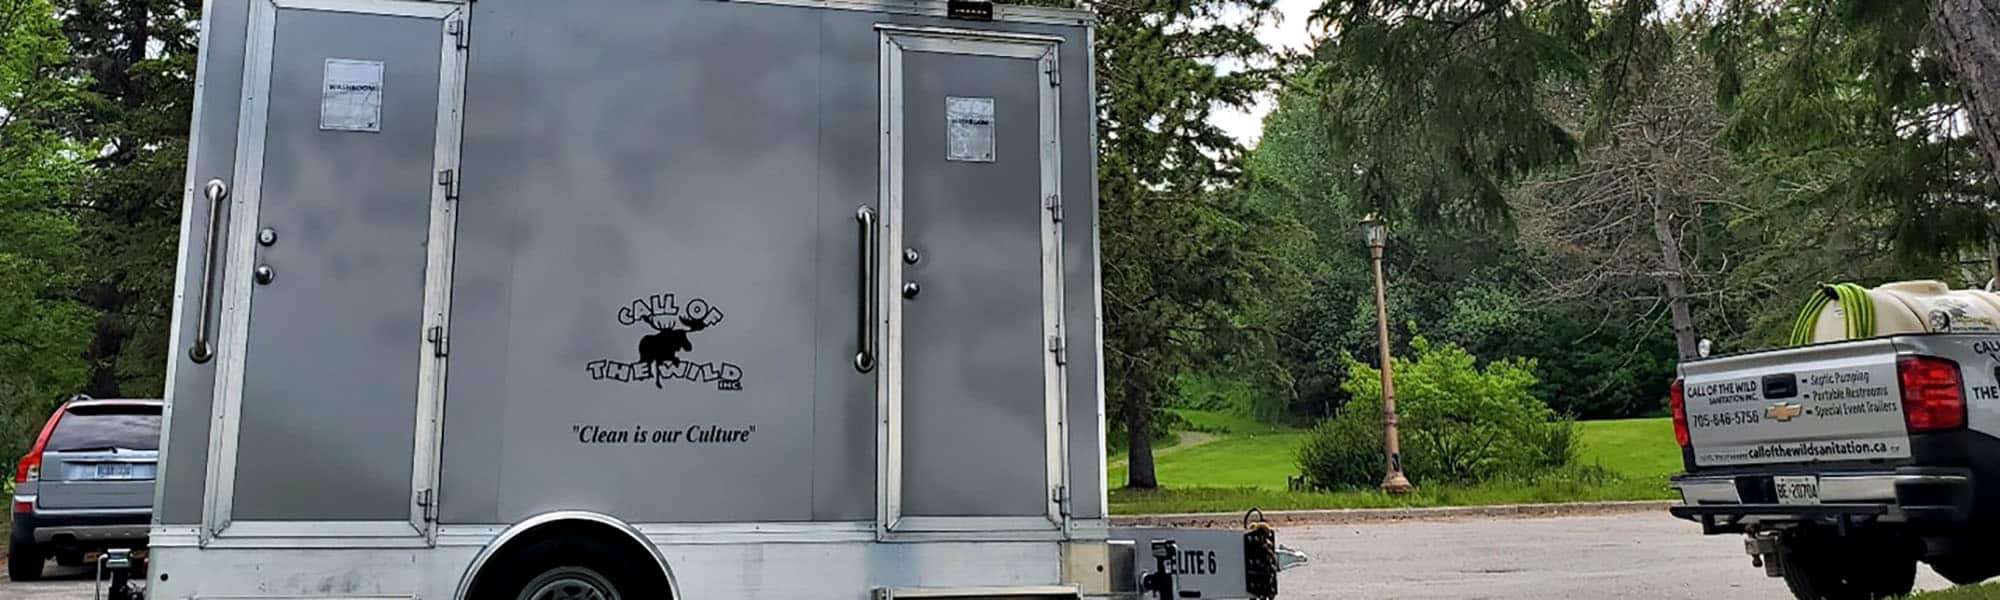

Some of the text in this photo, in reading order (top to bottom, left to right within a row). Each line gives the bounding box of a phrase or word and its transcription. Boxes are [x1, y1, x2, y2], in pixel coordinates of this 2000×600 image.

[618, 293, 724, 327] CALL OF
[586, 360, 743, 382] THE WILD
[1811, 371, 1869, 386] Septic Pumping
[1687, 380, 1757, 398] CALL OF THE WILD
[1812, 386, 1888, 401] Portable Restrooms
[1972, 386, 1999, 400] THE
[1709, 395, 1745, 405] SANITATION
[1815, 400, 1897, 418] Special Event Trailers
[573, 425, 756, 443] "Clean is our Culture"
[1748, 441, 1888, 459] callofthewildsanitation.ca
[1208, 550, 1217, 574] 6
